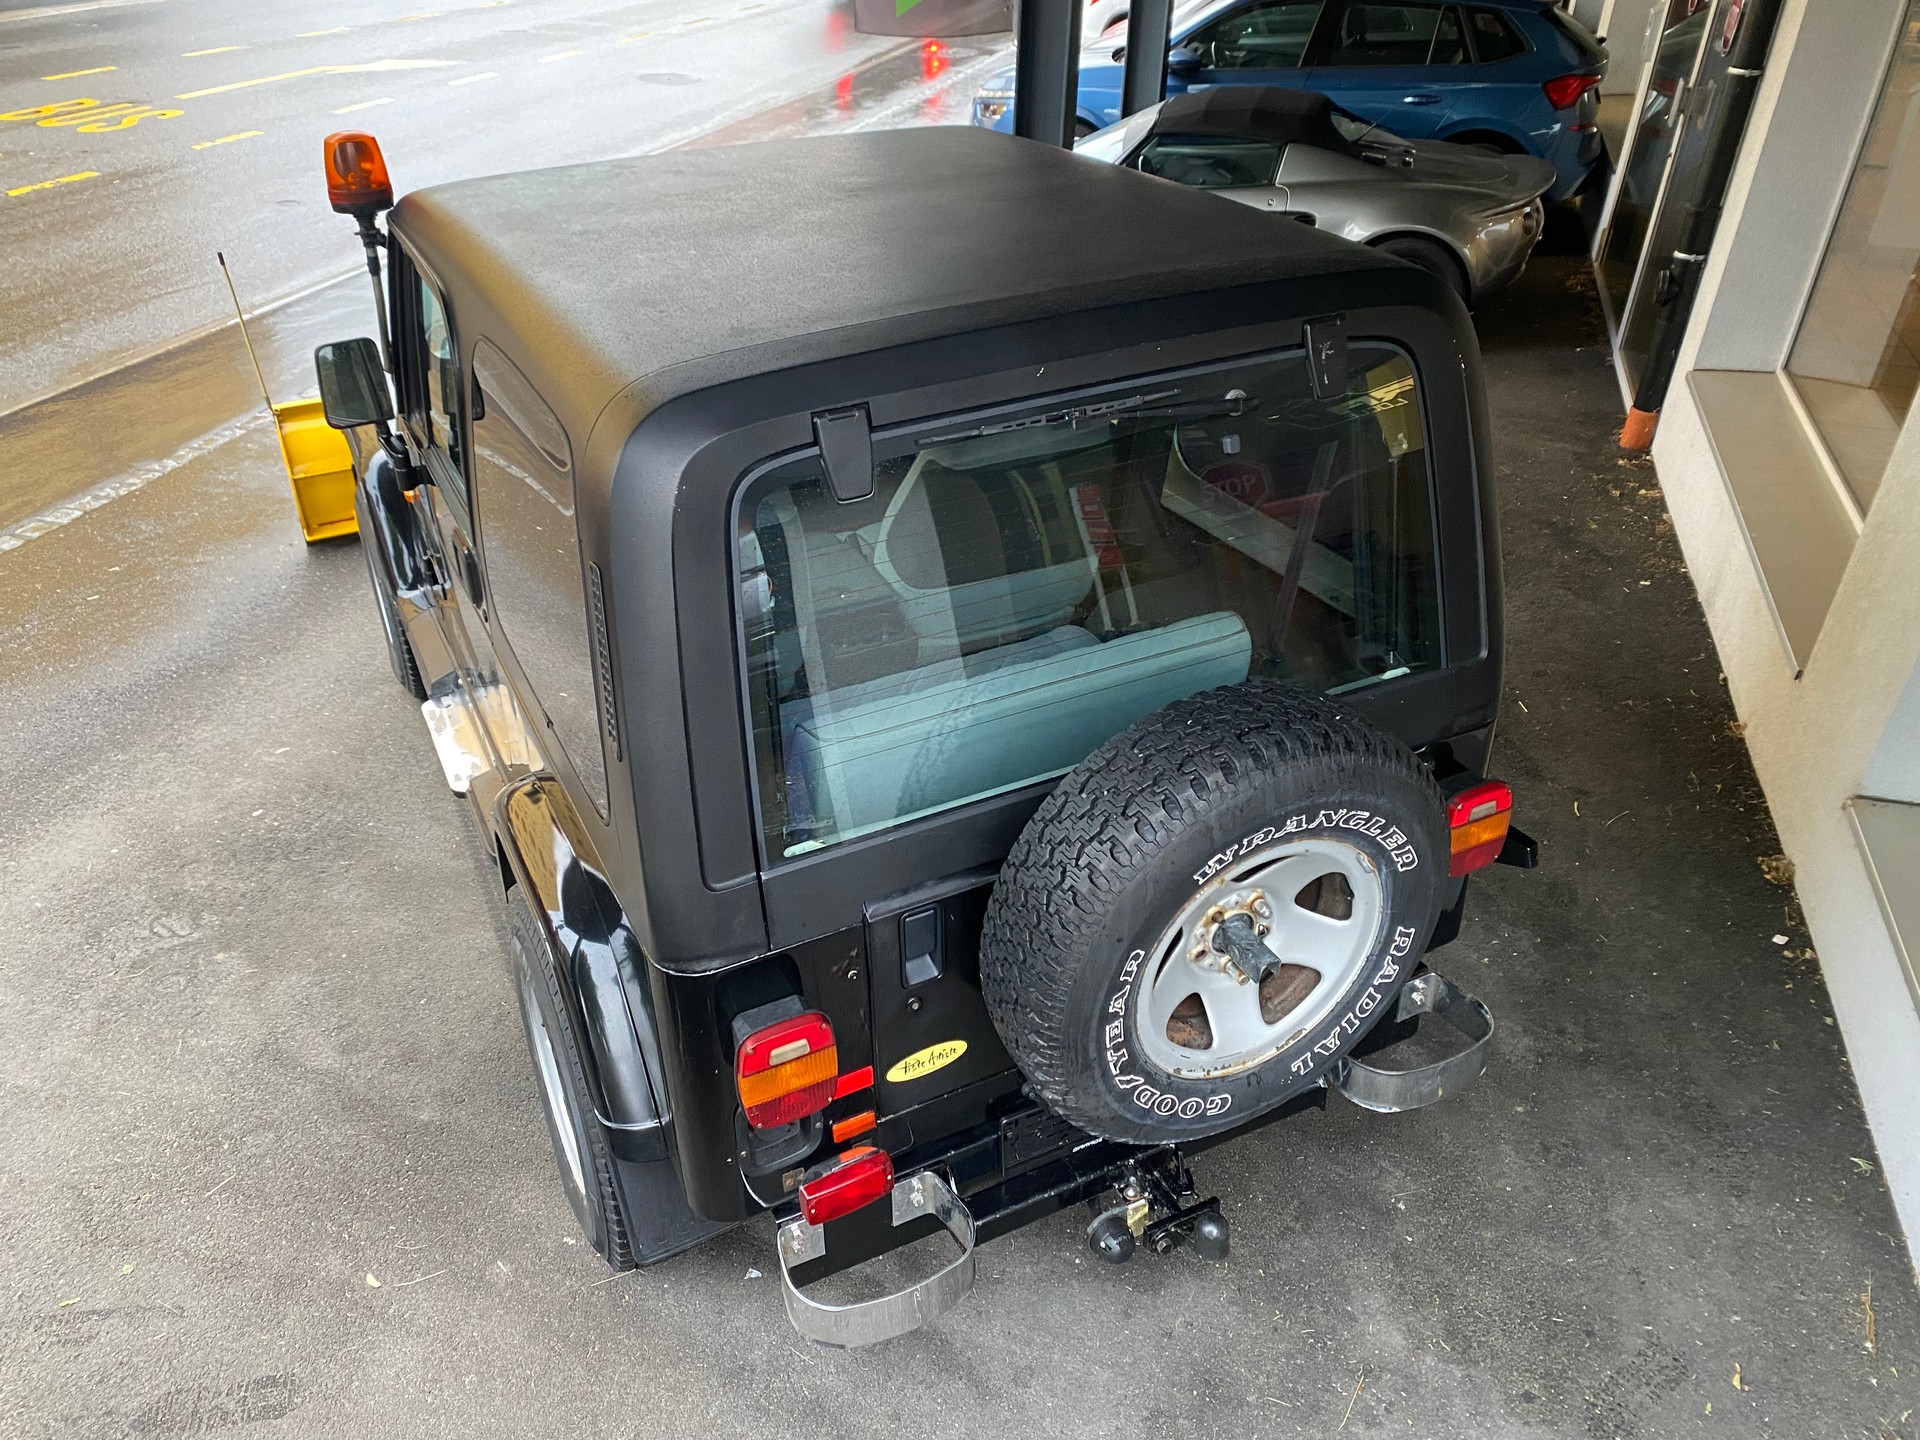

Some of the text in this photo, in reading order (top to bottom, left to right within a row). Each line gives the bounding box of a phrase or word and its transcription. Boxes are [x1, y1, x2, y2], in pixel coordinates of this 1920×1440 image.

[0, 97, 184, 133] BUS
[1193, 808, 1419, 885] WRANGLER
[1105, 949, 1232, 1119] GOODYEAR
[1291, 926, 1416, 1076] RADIAL
